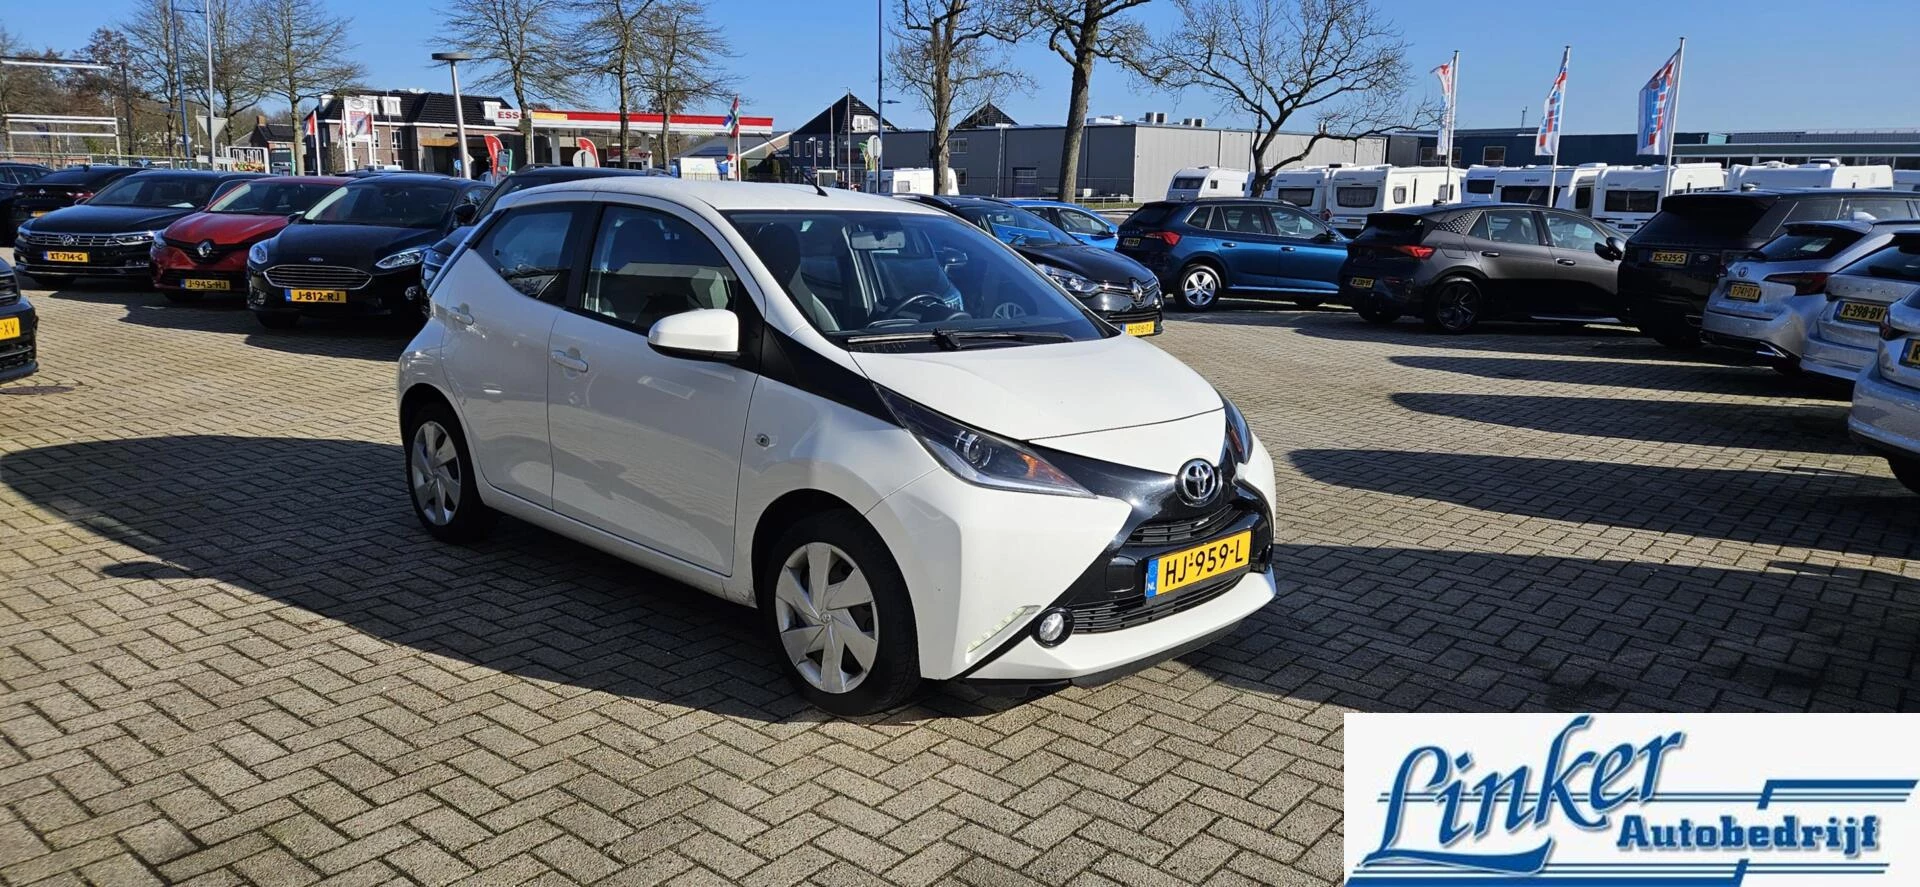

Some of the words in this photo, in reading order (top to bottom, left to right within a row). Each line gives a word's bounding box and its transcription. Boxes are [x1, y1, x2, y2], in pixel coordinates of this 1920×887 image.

[51, 253, 83, 261] XT-714-G
[296, 291, 341, 301] J-812-RJ
[1842, 304, 1884, 320] R-398-BV
[1165, 546, 1243, 586] HJ-959-L
[1147, 582, 1156, 592] NL
